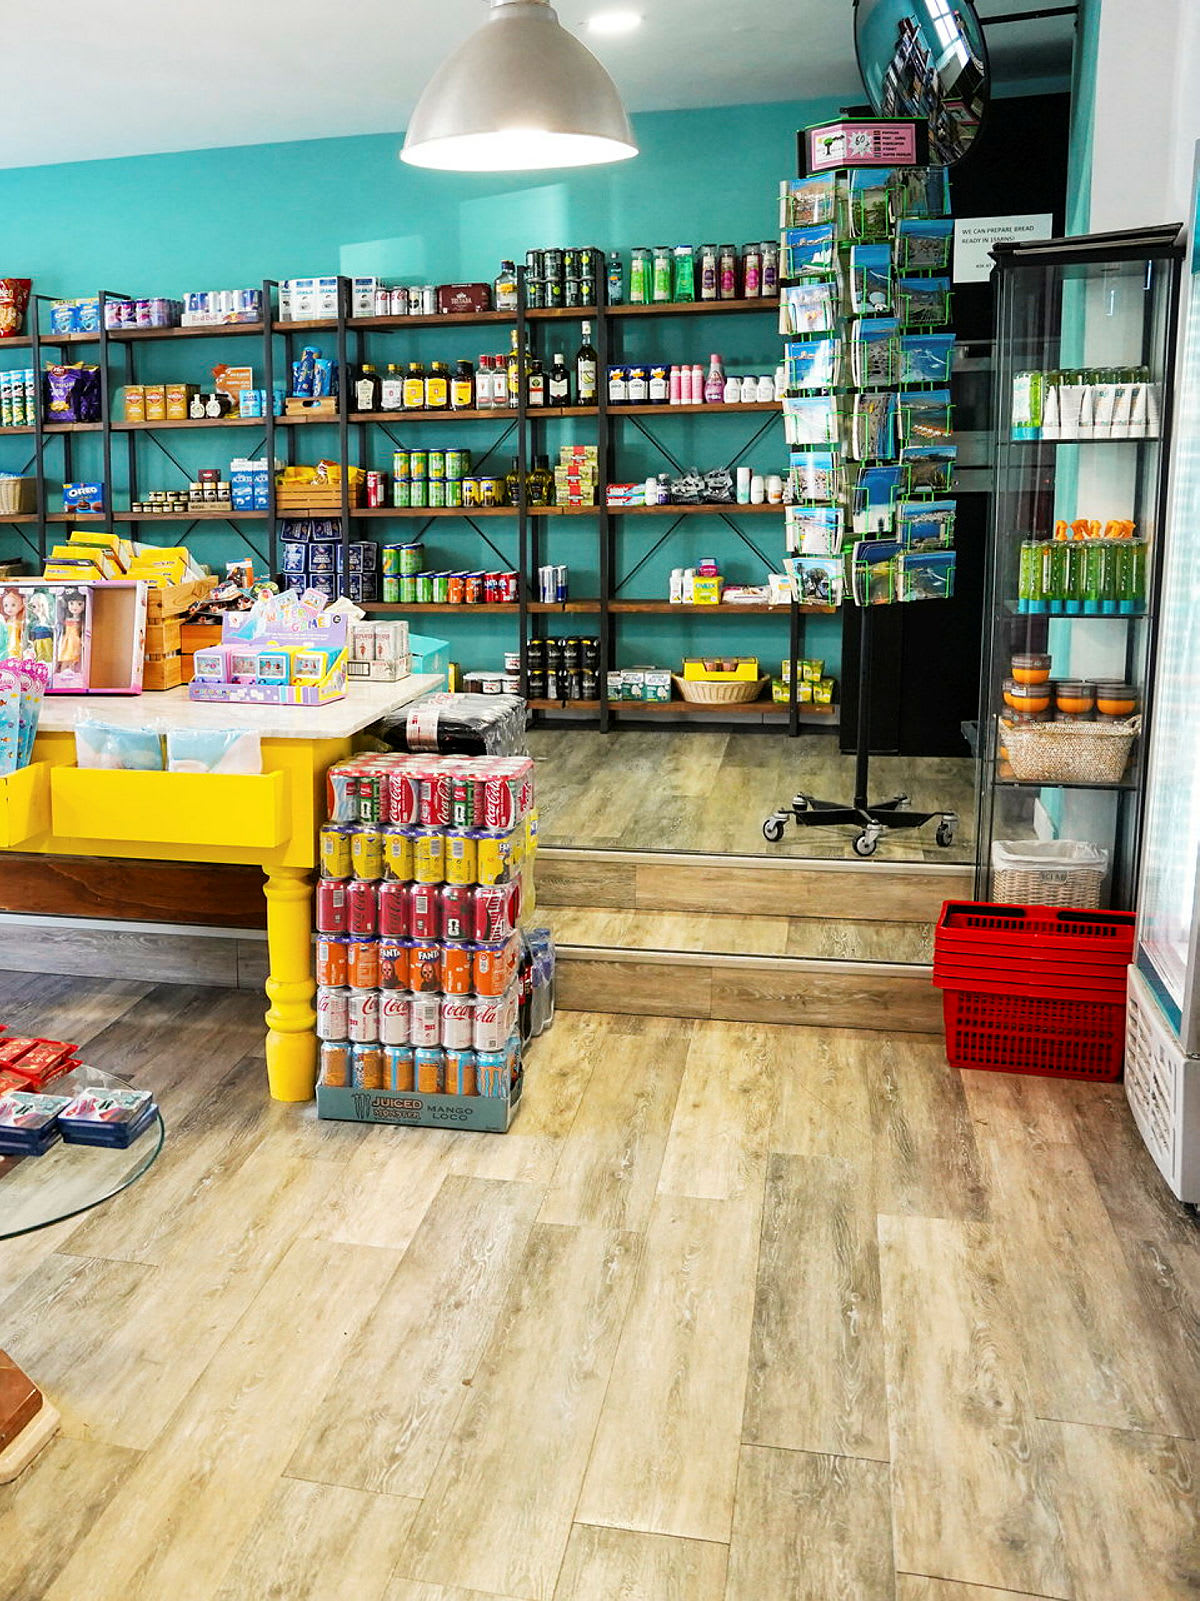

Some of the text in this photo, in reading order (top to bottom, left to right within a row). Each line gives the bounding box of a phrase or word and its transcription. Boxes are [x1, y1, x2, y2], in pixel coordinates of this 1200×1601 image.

[191, 313, 218, 322] Red Bull
[68, 486, 98, 498] OREO
[292, 616, 328, 632] GAME
[388, 773, 402, 824] Coca-Cola
[484, 777, 502, 829] Coca-Cola
[372, 1096, 424, 1110] JUICED
[427, 1105, 474, 1115] MANGO
[432, 1113, 468, 1122] LOCO
